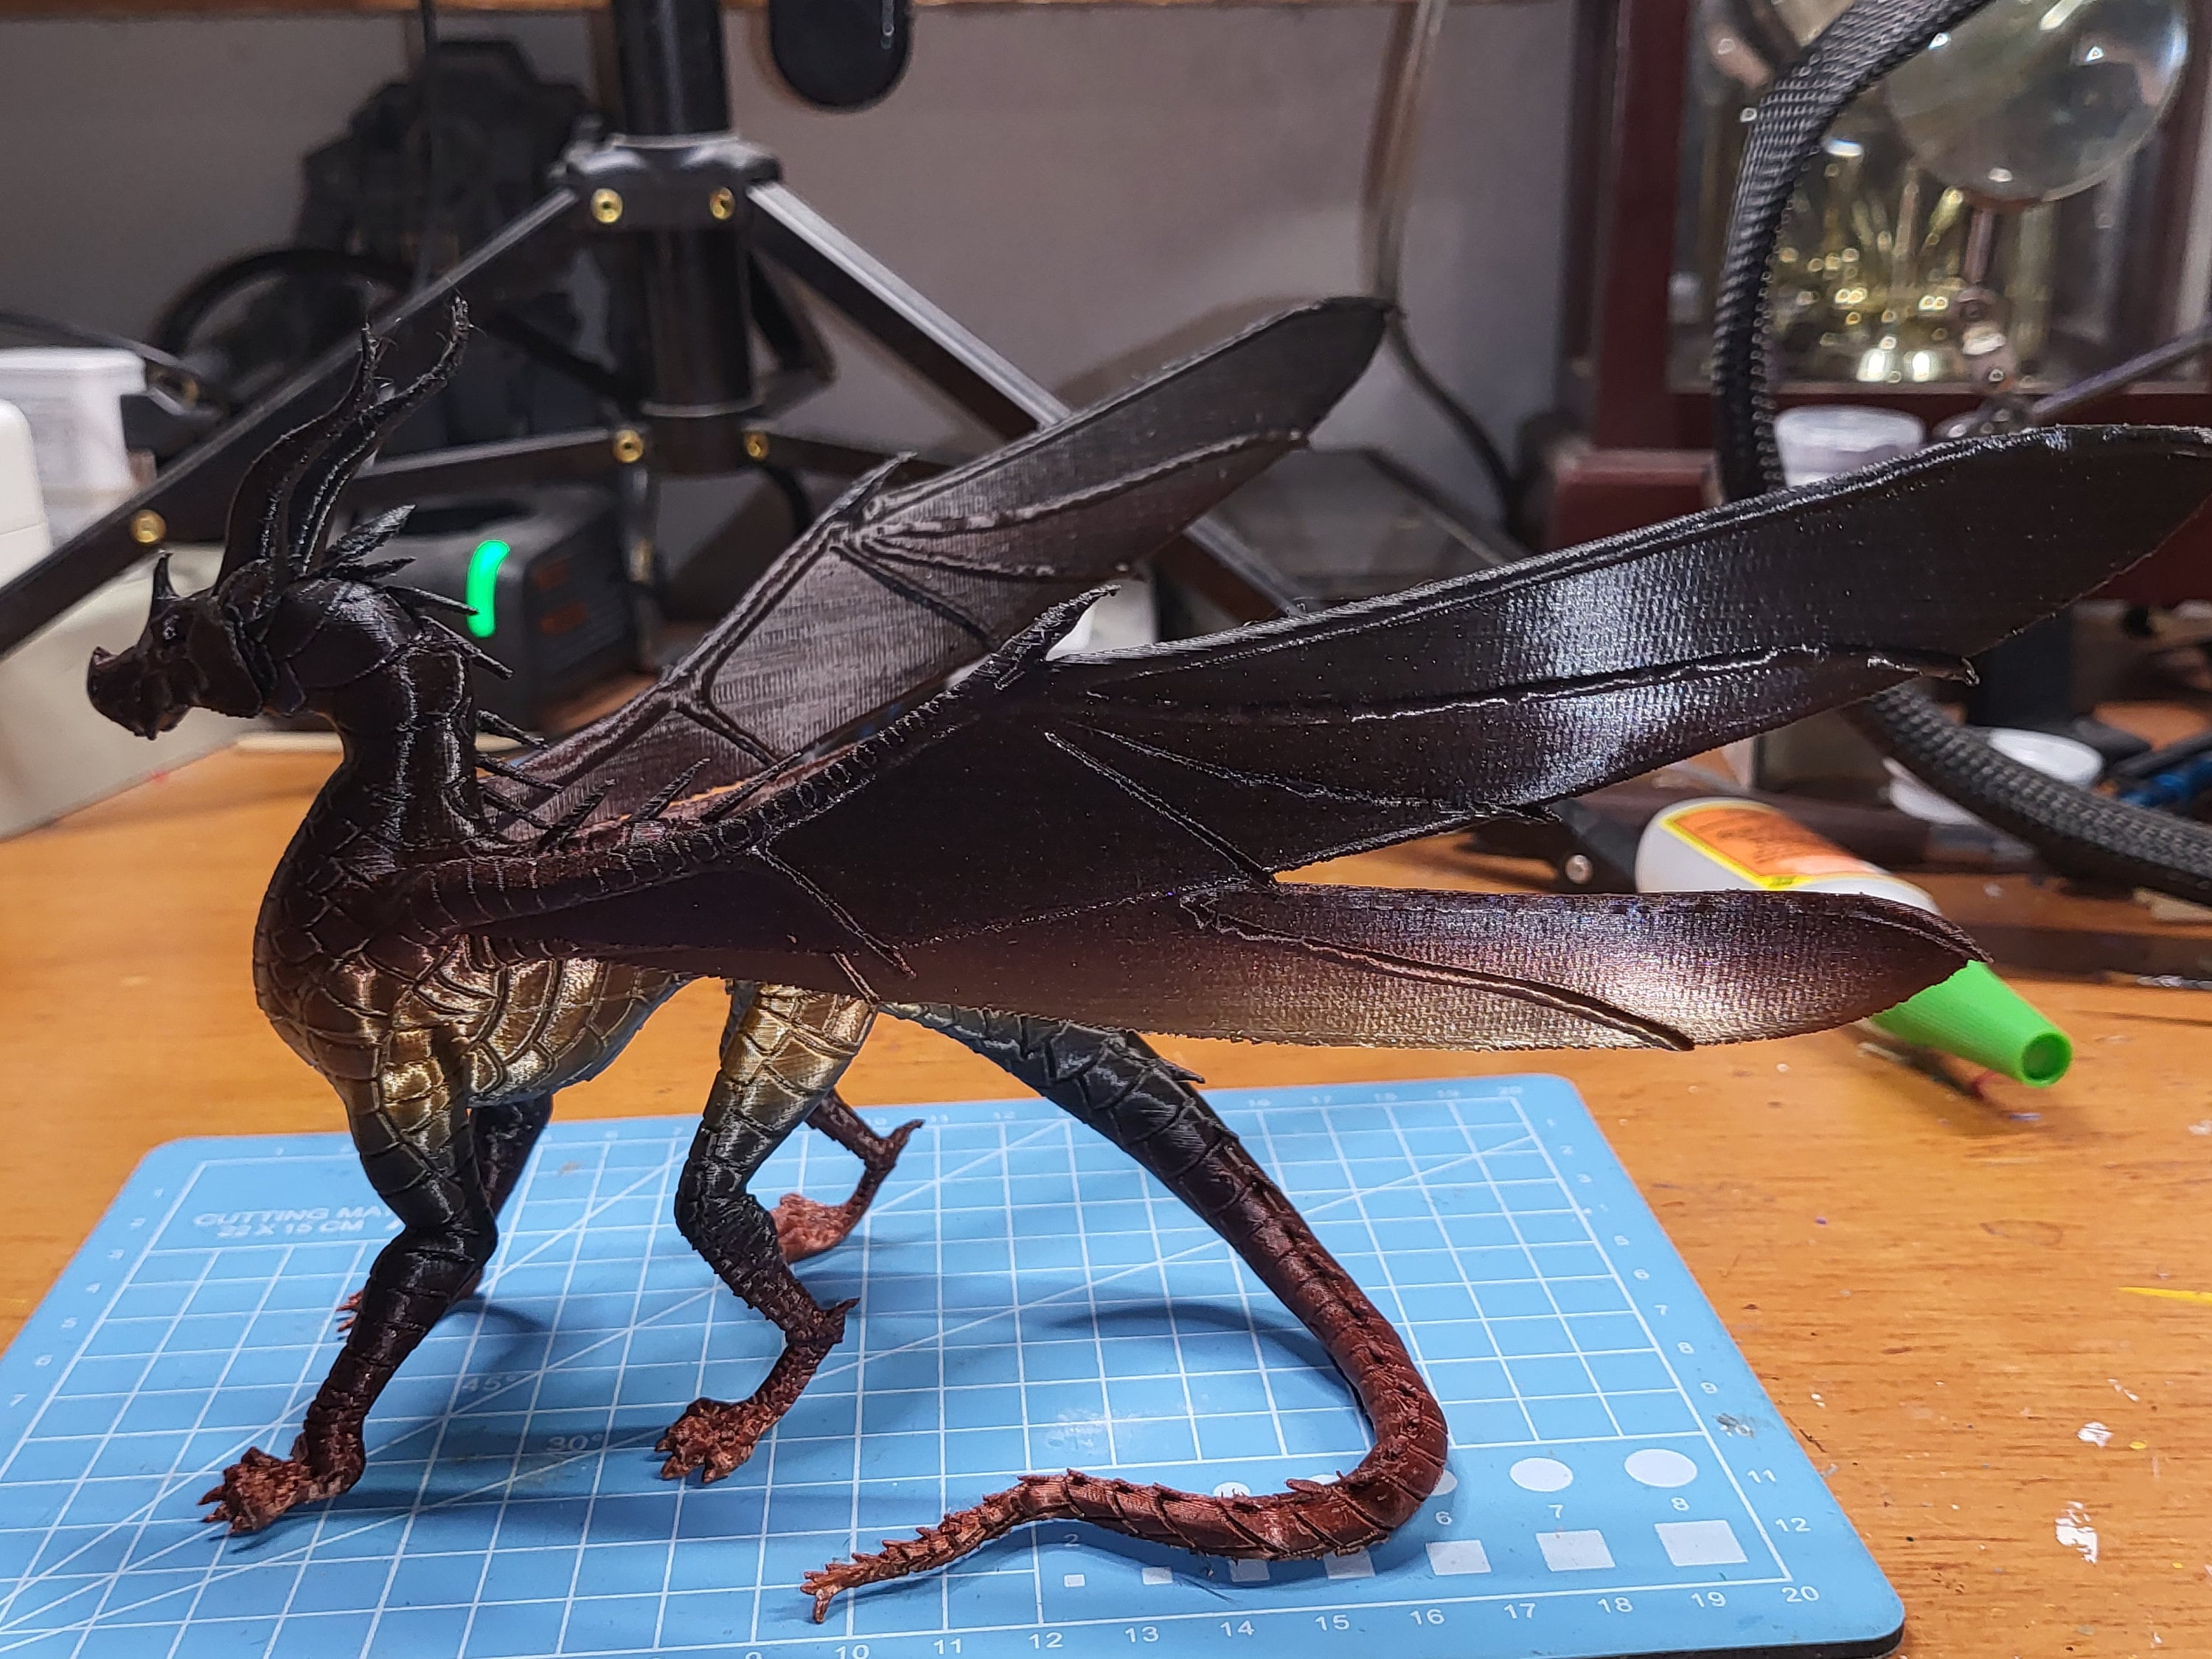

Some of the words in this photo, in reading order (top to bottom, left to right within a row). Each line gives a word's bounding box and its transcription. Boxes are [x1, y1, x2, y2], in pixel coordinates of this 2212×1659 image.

[192, 1207, 330, 1226] CUTTING
[319, 1219, 365, 1233] CM
[1633, 1268, 1650, 1281] 6
[1654, 1304, 1668, 1316] 7
[1677, 1341, 1695, 1354] 8
[1700, 1381, 1719, 1394] 9
[9, 1393, 28, 1407] 7
[1747, 1470, 1777, 1484] 11
[1435, 1510, 1453, 1526] 6
[1548, 1504, 1564, 1519] 7
[1670, 1497, 1691, 1512] 8
[1775, 1516, 1812, 1533] 12
[1063, 1533, 1081, 1547] 2
[834, 1644, 871, 1659] 10
[933, 1638, 964, 1655] 11
[1029, 1632, 1064, 1649] 12
[1124, 1626, 1160, 1644] 13
[1220, 1620, 1255, 1637] 14
[1315, 1614, 1350, 1632] 15
[1410, 1609, 1446, 1626] 16
[1503, 1602, 1536, 1619] 17
[1597, 1596, 1634, 1613] 18
[1691, 1590, 1727, 1608] 19
[1781, 1585, 1820, 1603] 20
